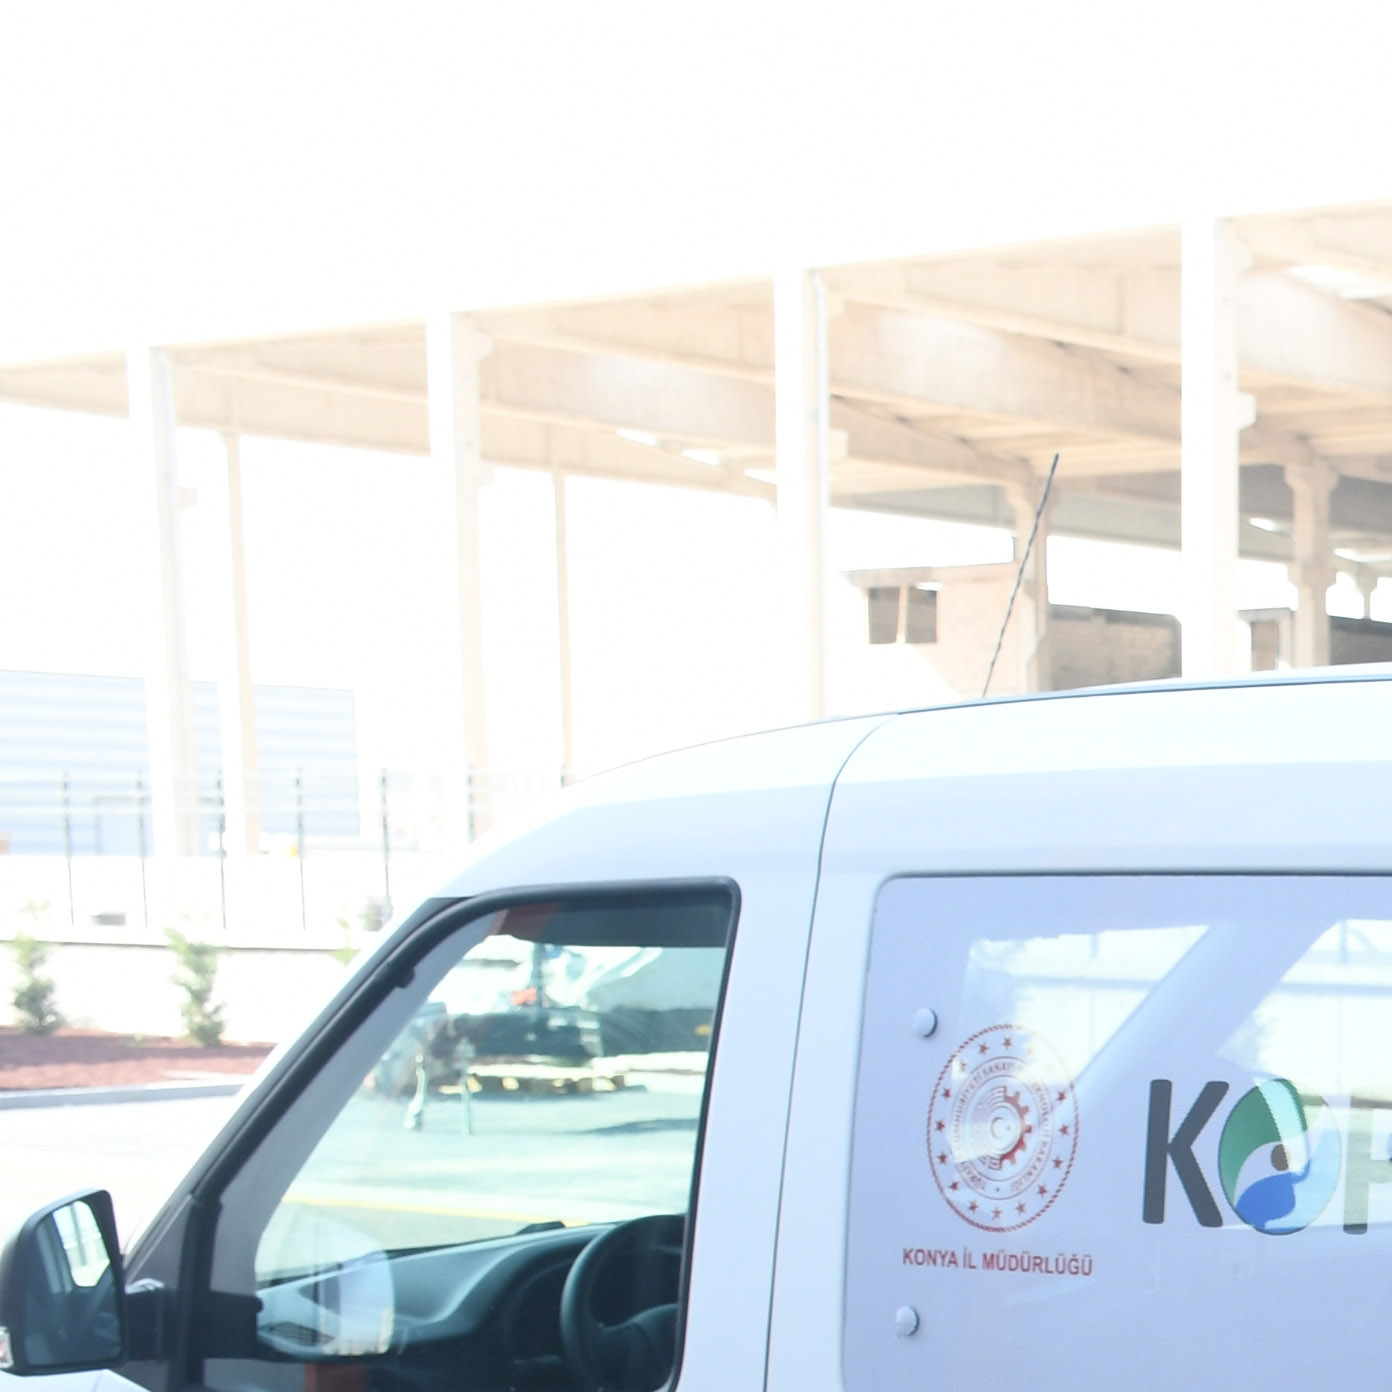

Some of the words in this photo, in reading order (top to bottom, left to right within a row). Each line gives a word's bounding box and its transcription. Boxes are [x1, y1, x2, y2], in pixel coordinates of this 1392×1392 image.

[902, 1247, 959, 1269] KONYA
[962, 1247, 977, 1269] İL
[981, 1249, 1093, 1277] MÜDÜRLÜĞÜ
